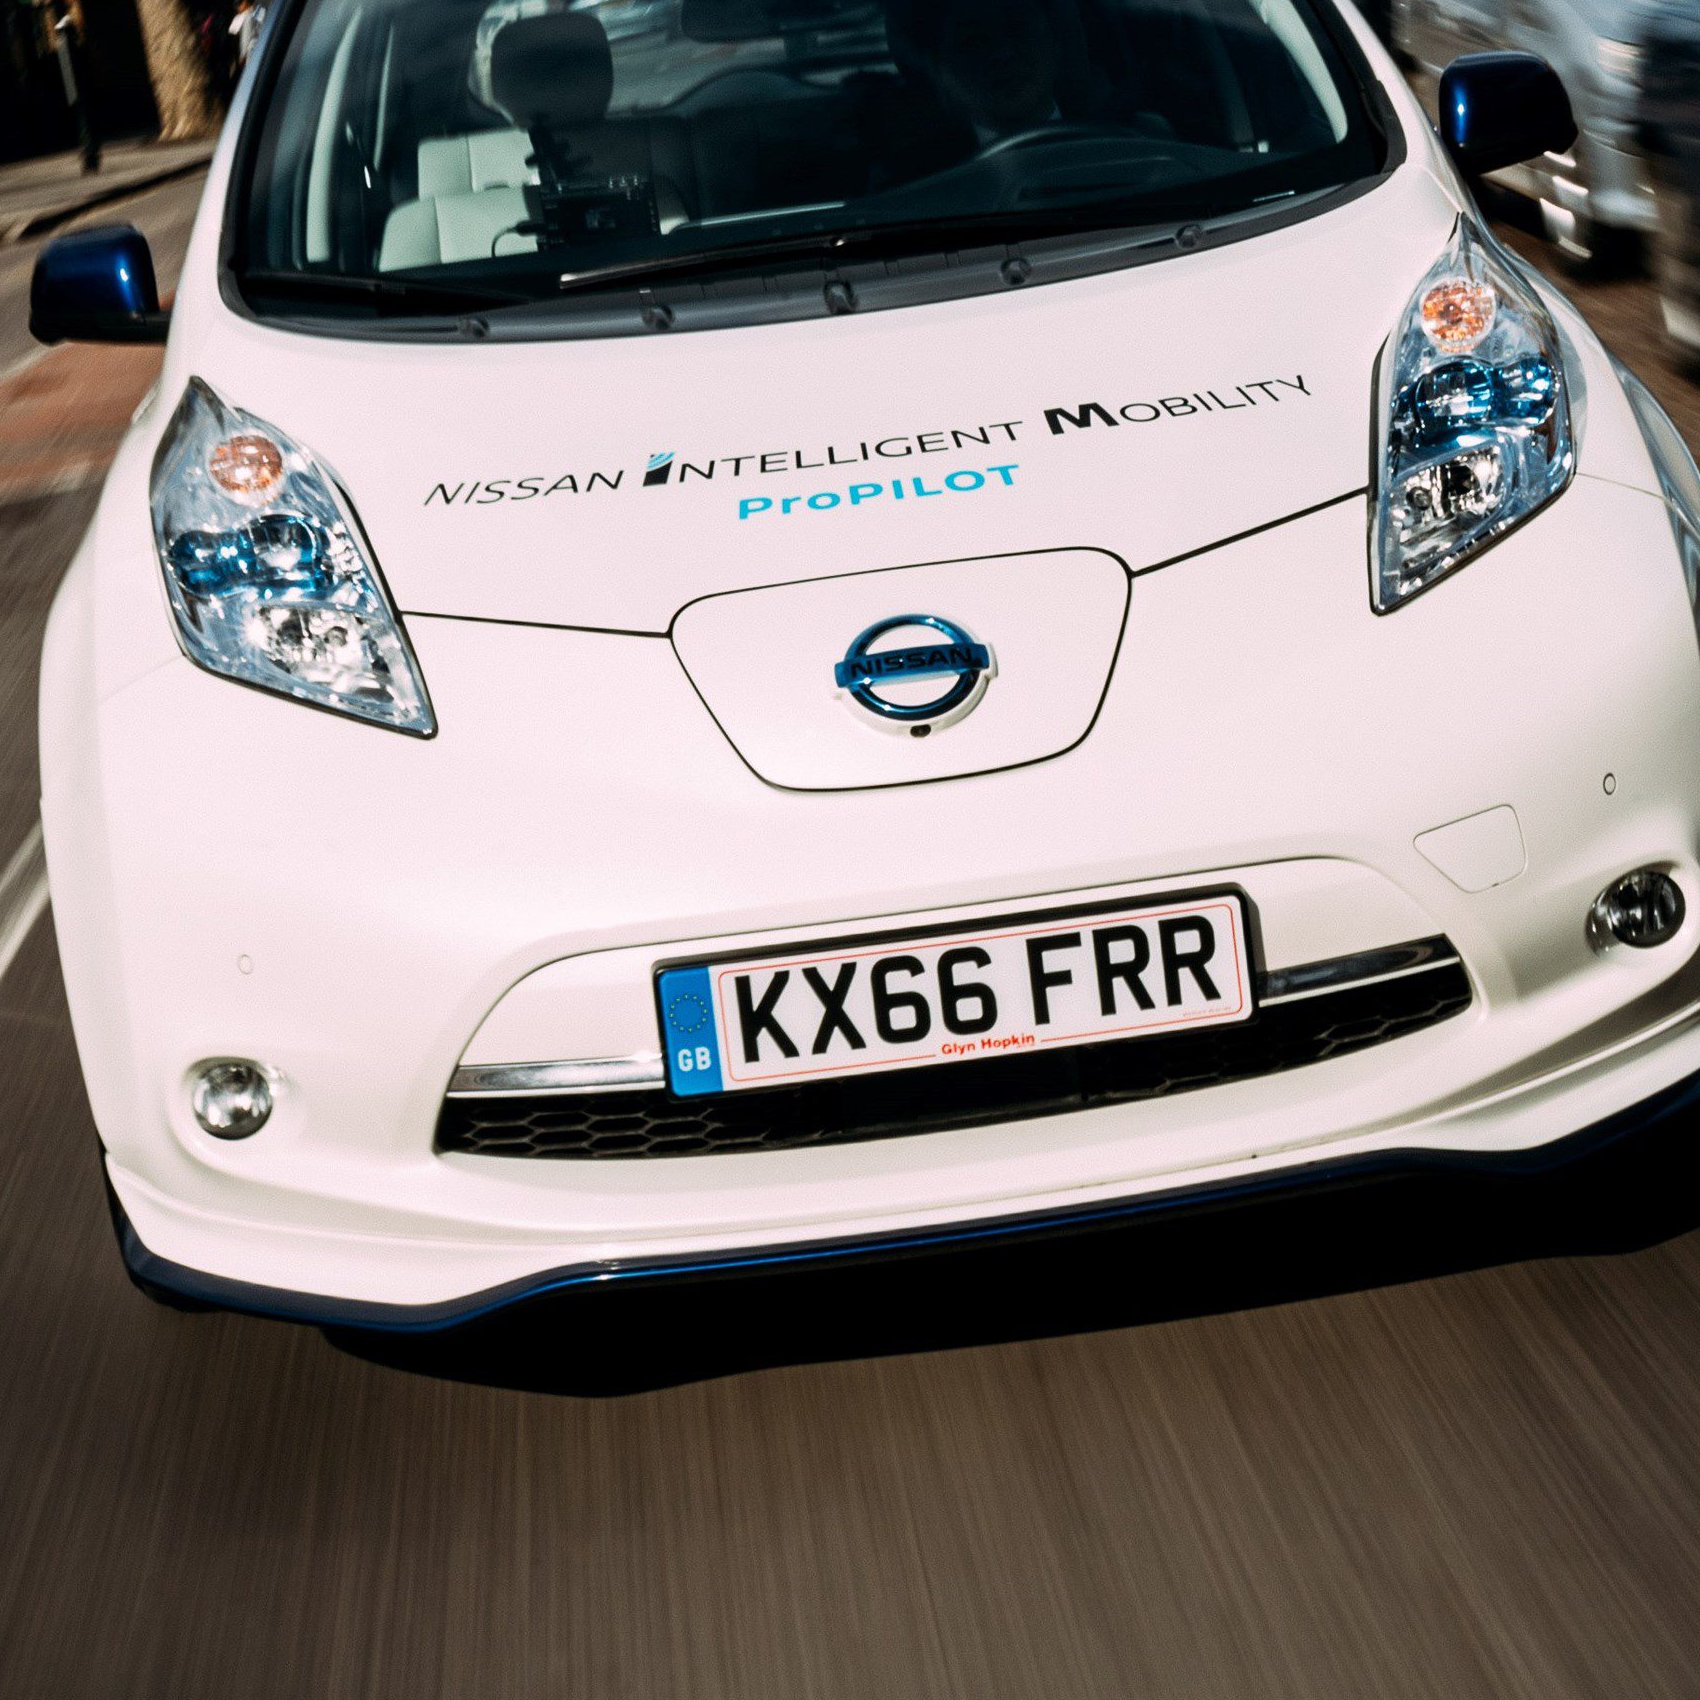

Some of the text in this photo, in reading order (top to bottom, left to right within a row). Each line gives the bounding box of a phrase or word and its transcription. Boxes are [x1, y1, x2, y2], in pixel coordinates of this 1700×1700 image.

[423, 374, 1312, 506] NISSAN INTELLIGENT MOBILITY
[737, 463, 1021, 521] ProPILOT
[851, 646, 974, 679] NISSAN
[734, 914, 1222, 1064] KX66 FRR
[676, 1046, 712, 1073] GB
[941, 1032, 1035, 1056] Glyn Hopkin
